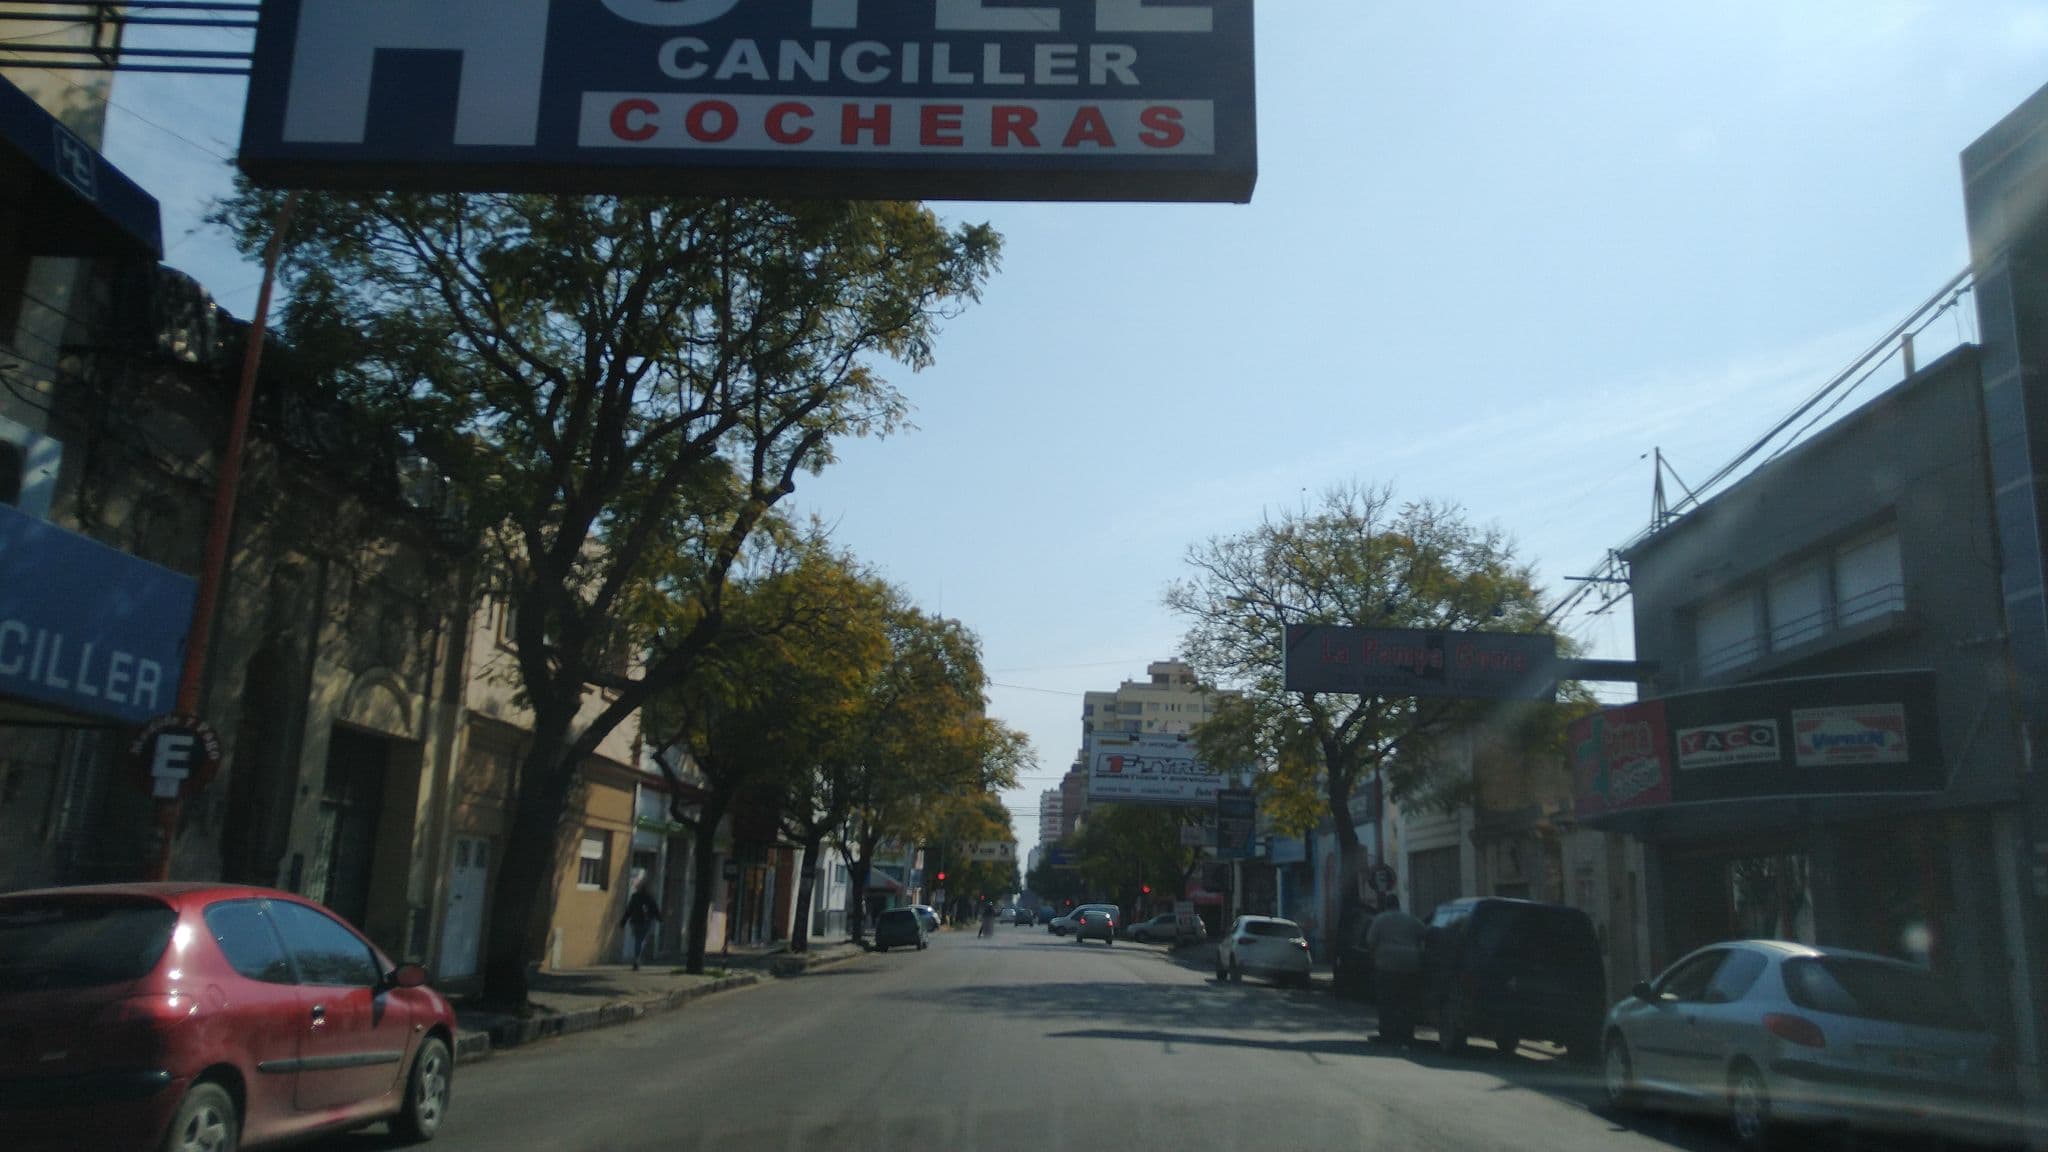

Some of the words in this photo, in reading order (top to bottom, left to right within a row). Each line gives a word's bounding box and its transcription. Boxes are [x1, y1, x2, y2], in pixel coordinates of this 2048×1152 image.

[657, 37, 1140, 86] CANCILLER
[609, 99, 1186, 149] COCHERAS
[151, 734, 194, 779] E
[1685, 728, 1771, 752] YACO
